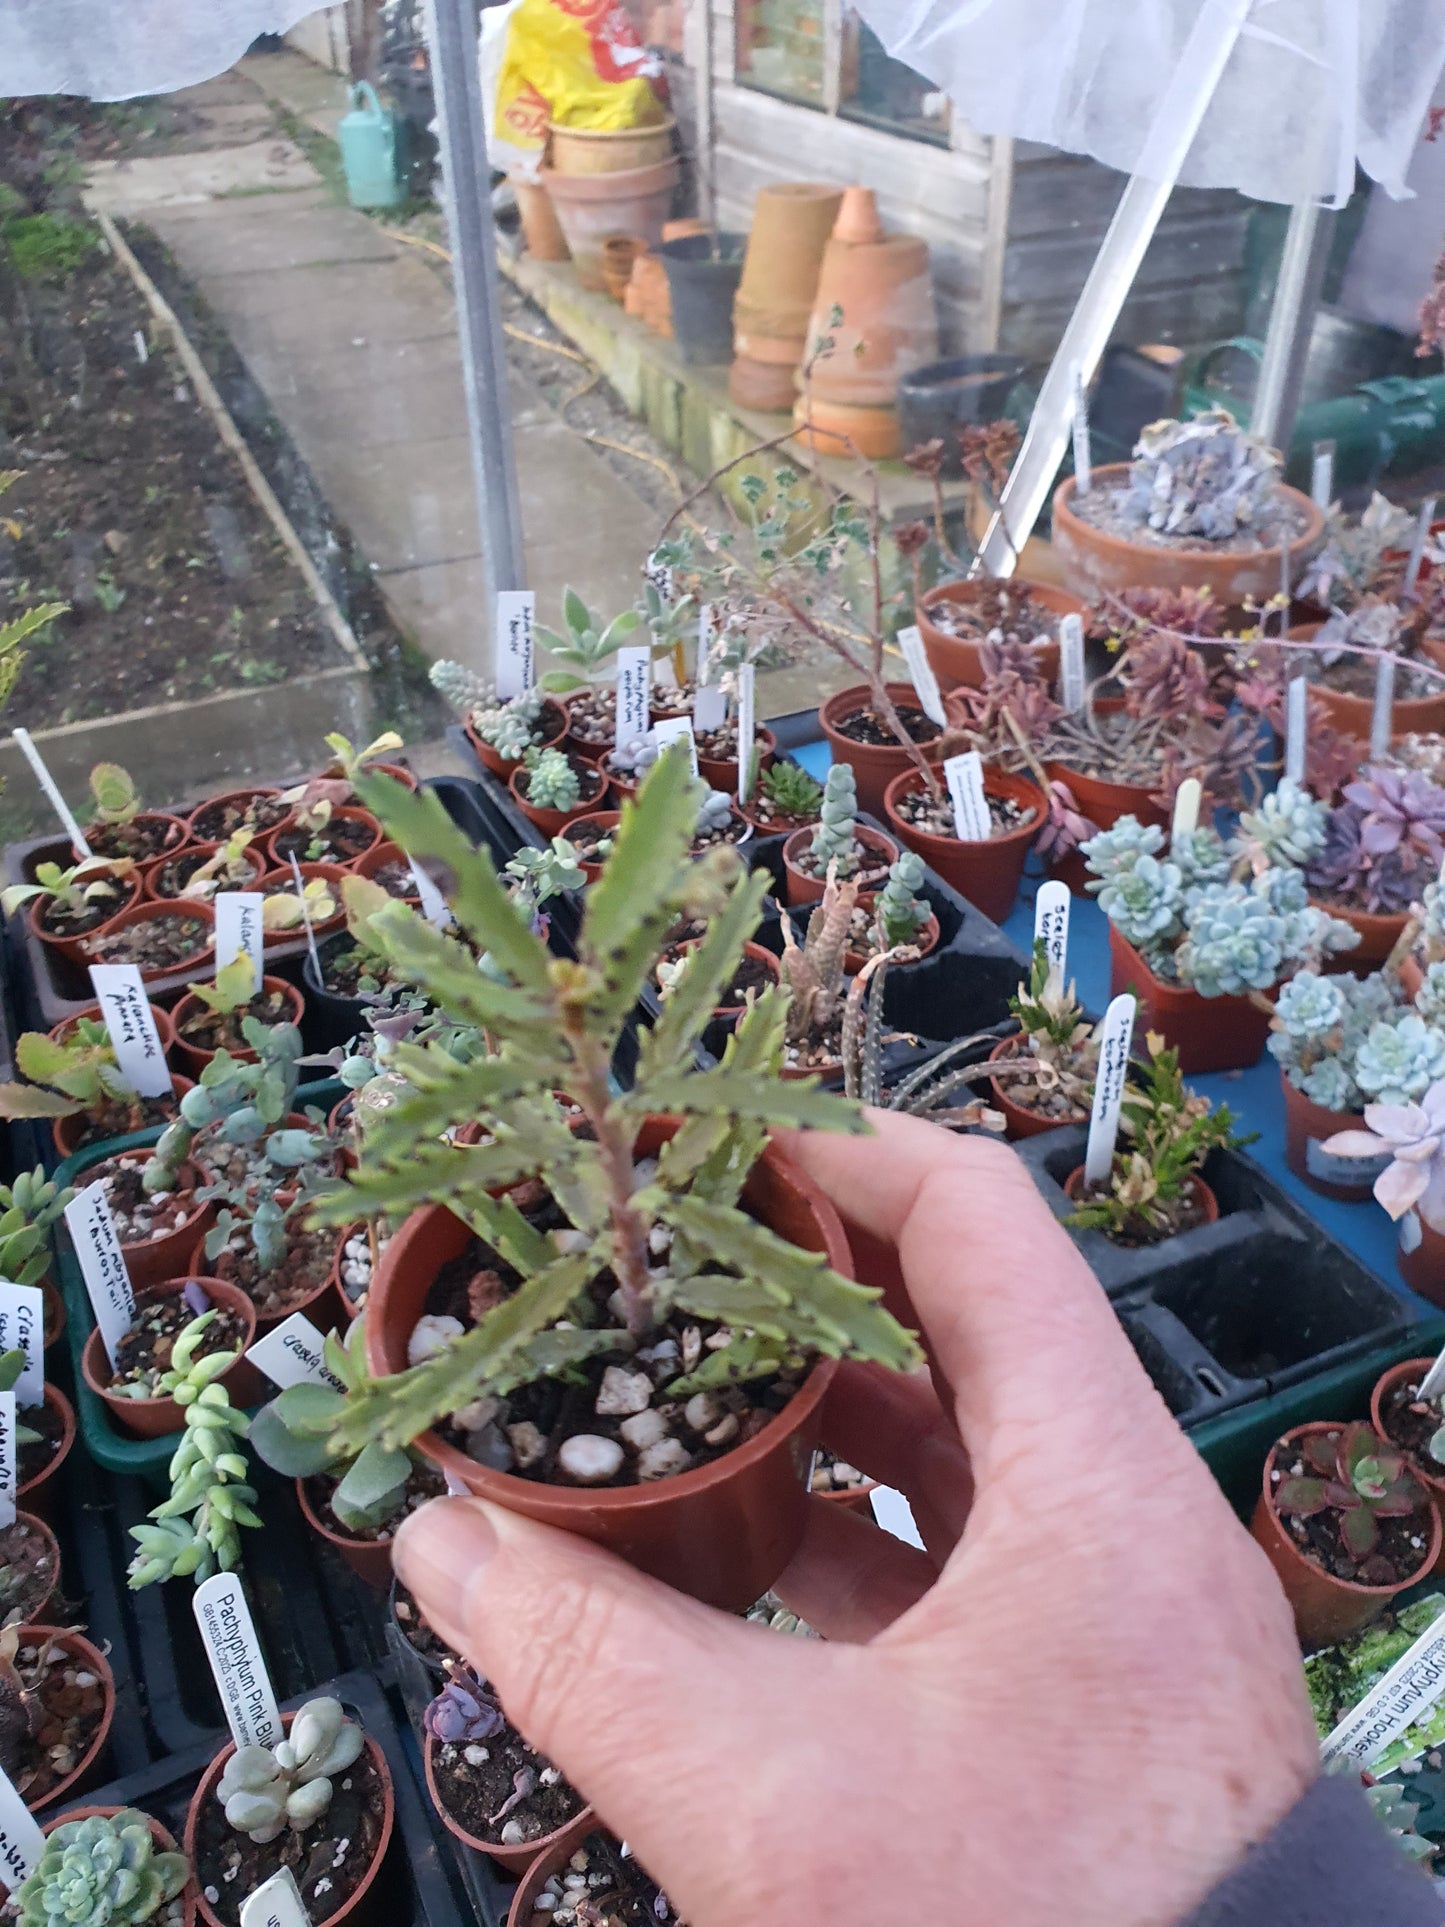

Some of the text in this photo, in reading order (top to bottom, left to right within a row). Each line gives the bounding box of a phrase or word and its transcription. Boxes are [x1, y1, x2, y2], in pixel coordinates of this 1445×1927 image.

[1051, 904, 1066, 961] Scelet
[217, 1593, 256, 1691] Pachyphytum
[245, 1688, 268, 1725] Pink
